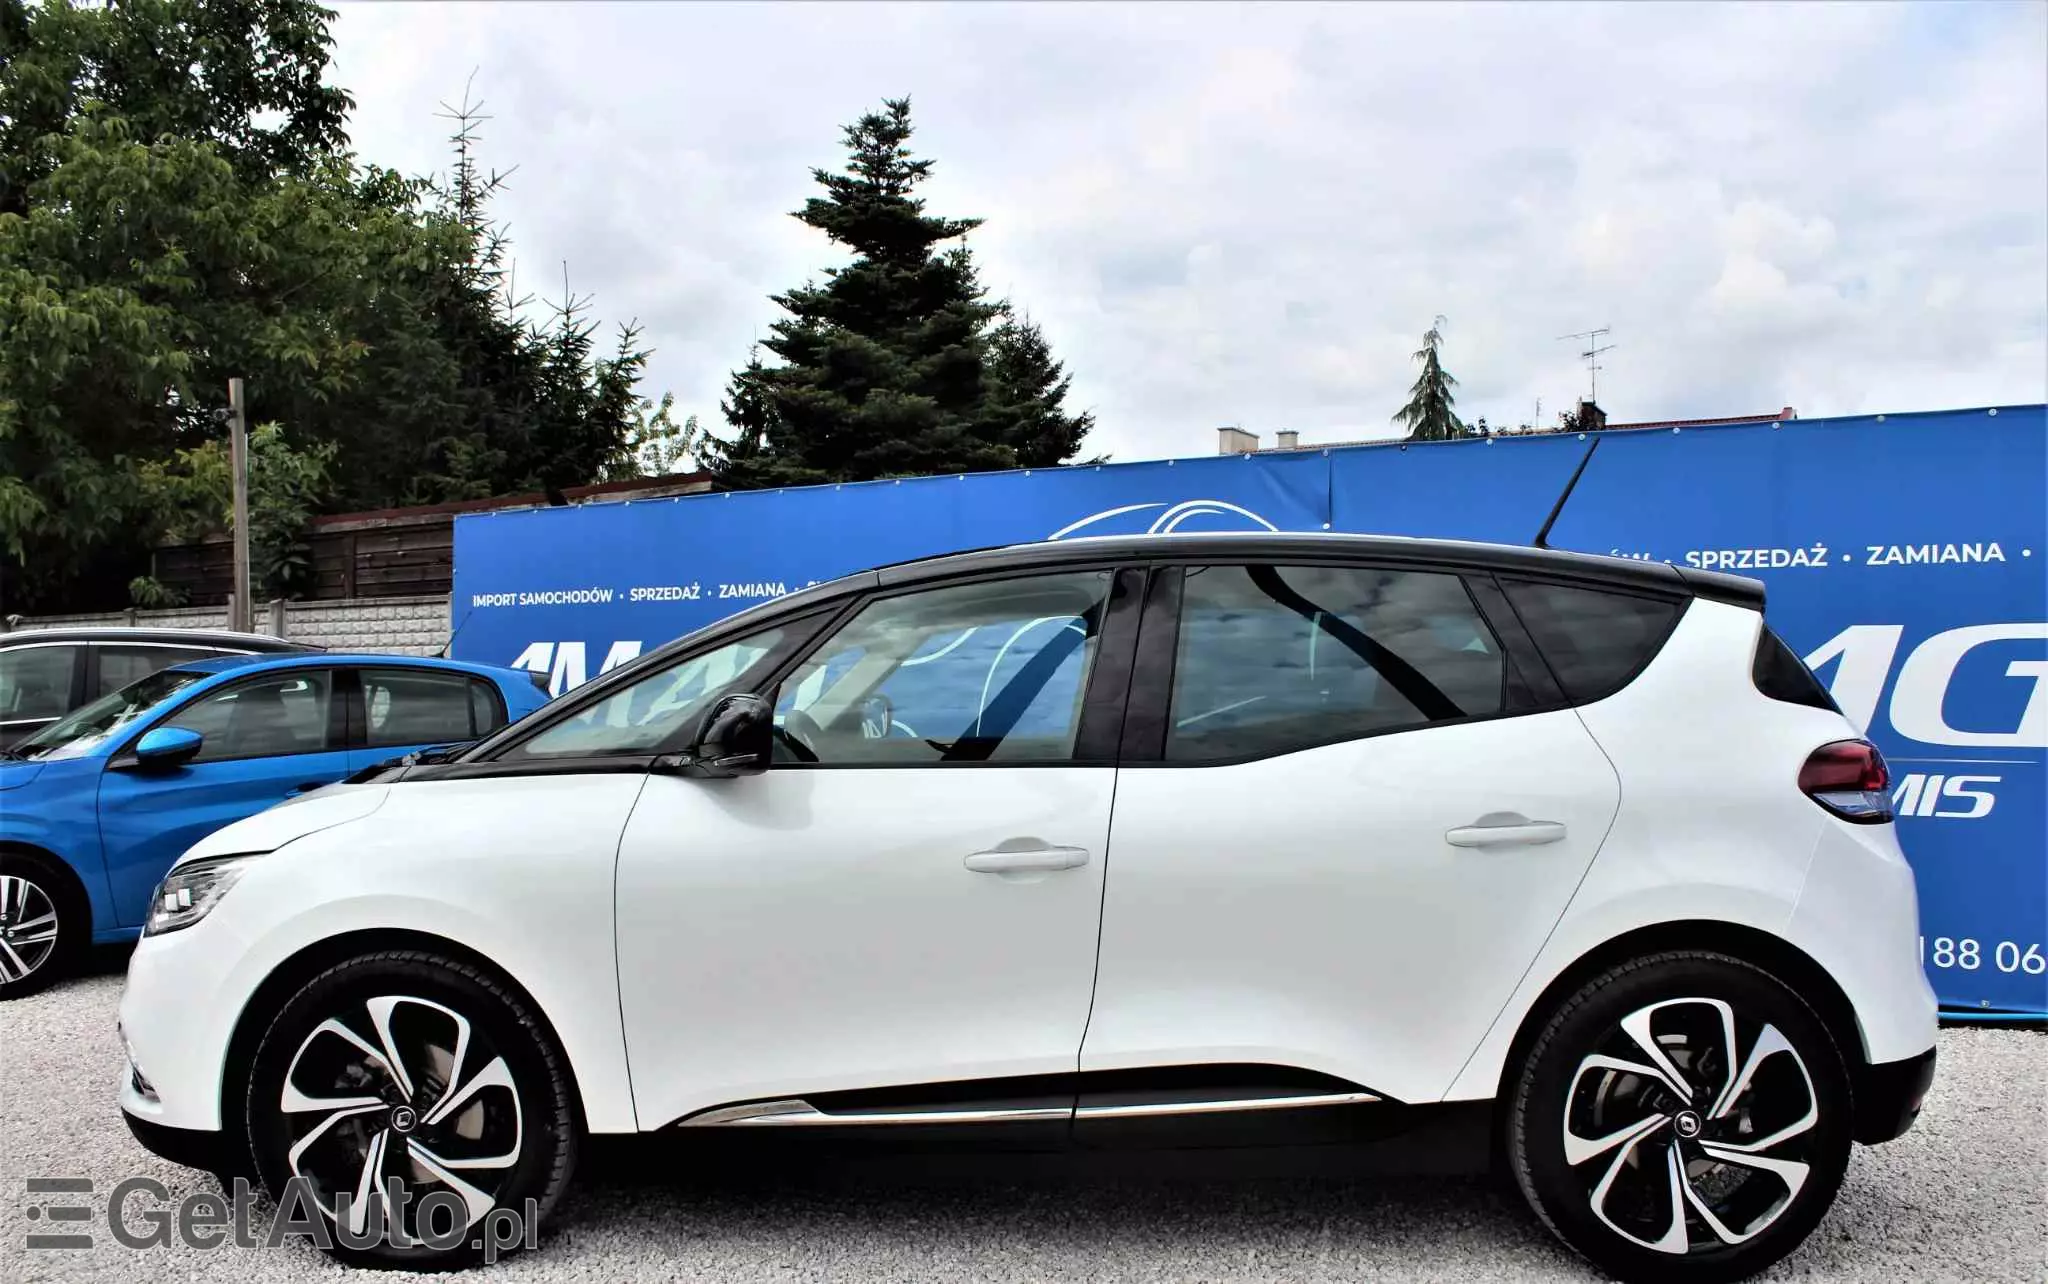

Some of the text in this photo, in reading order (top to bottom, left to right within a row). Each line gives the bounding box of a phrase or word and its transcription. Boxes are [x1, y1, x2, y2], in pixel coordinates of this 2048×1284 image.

[1685, 542, 2006, 569] SPRZEDAŻ ZAMIANA
[473, 582, 786, 607] IMPORT SAMOCHODÓW SPRZEDAŻ ZAMIANA
[1996, 941, 2046, 975] 06
